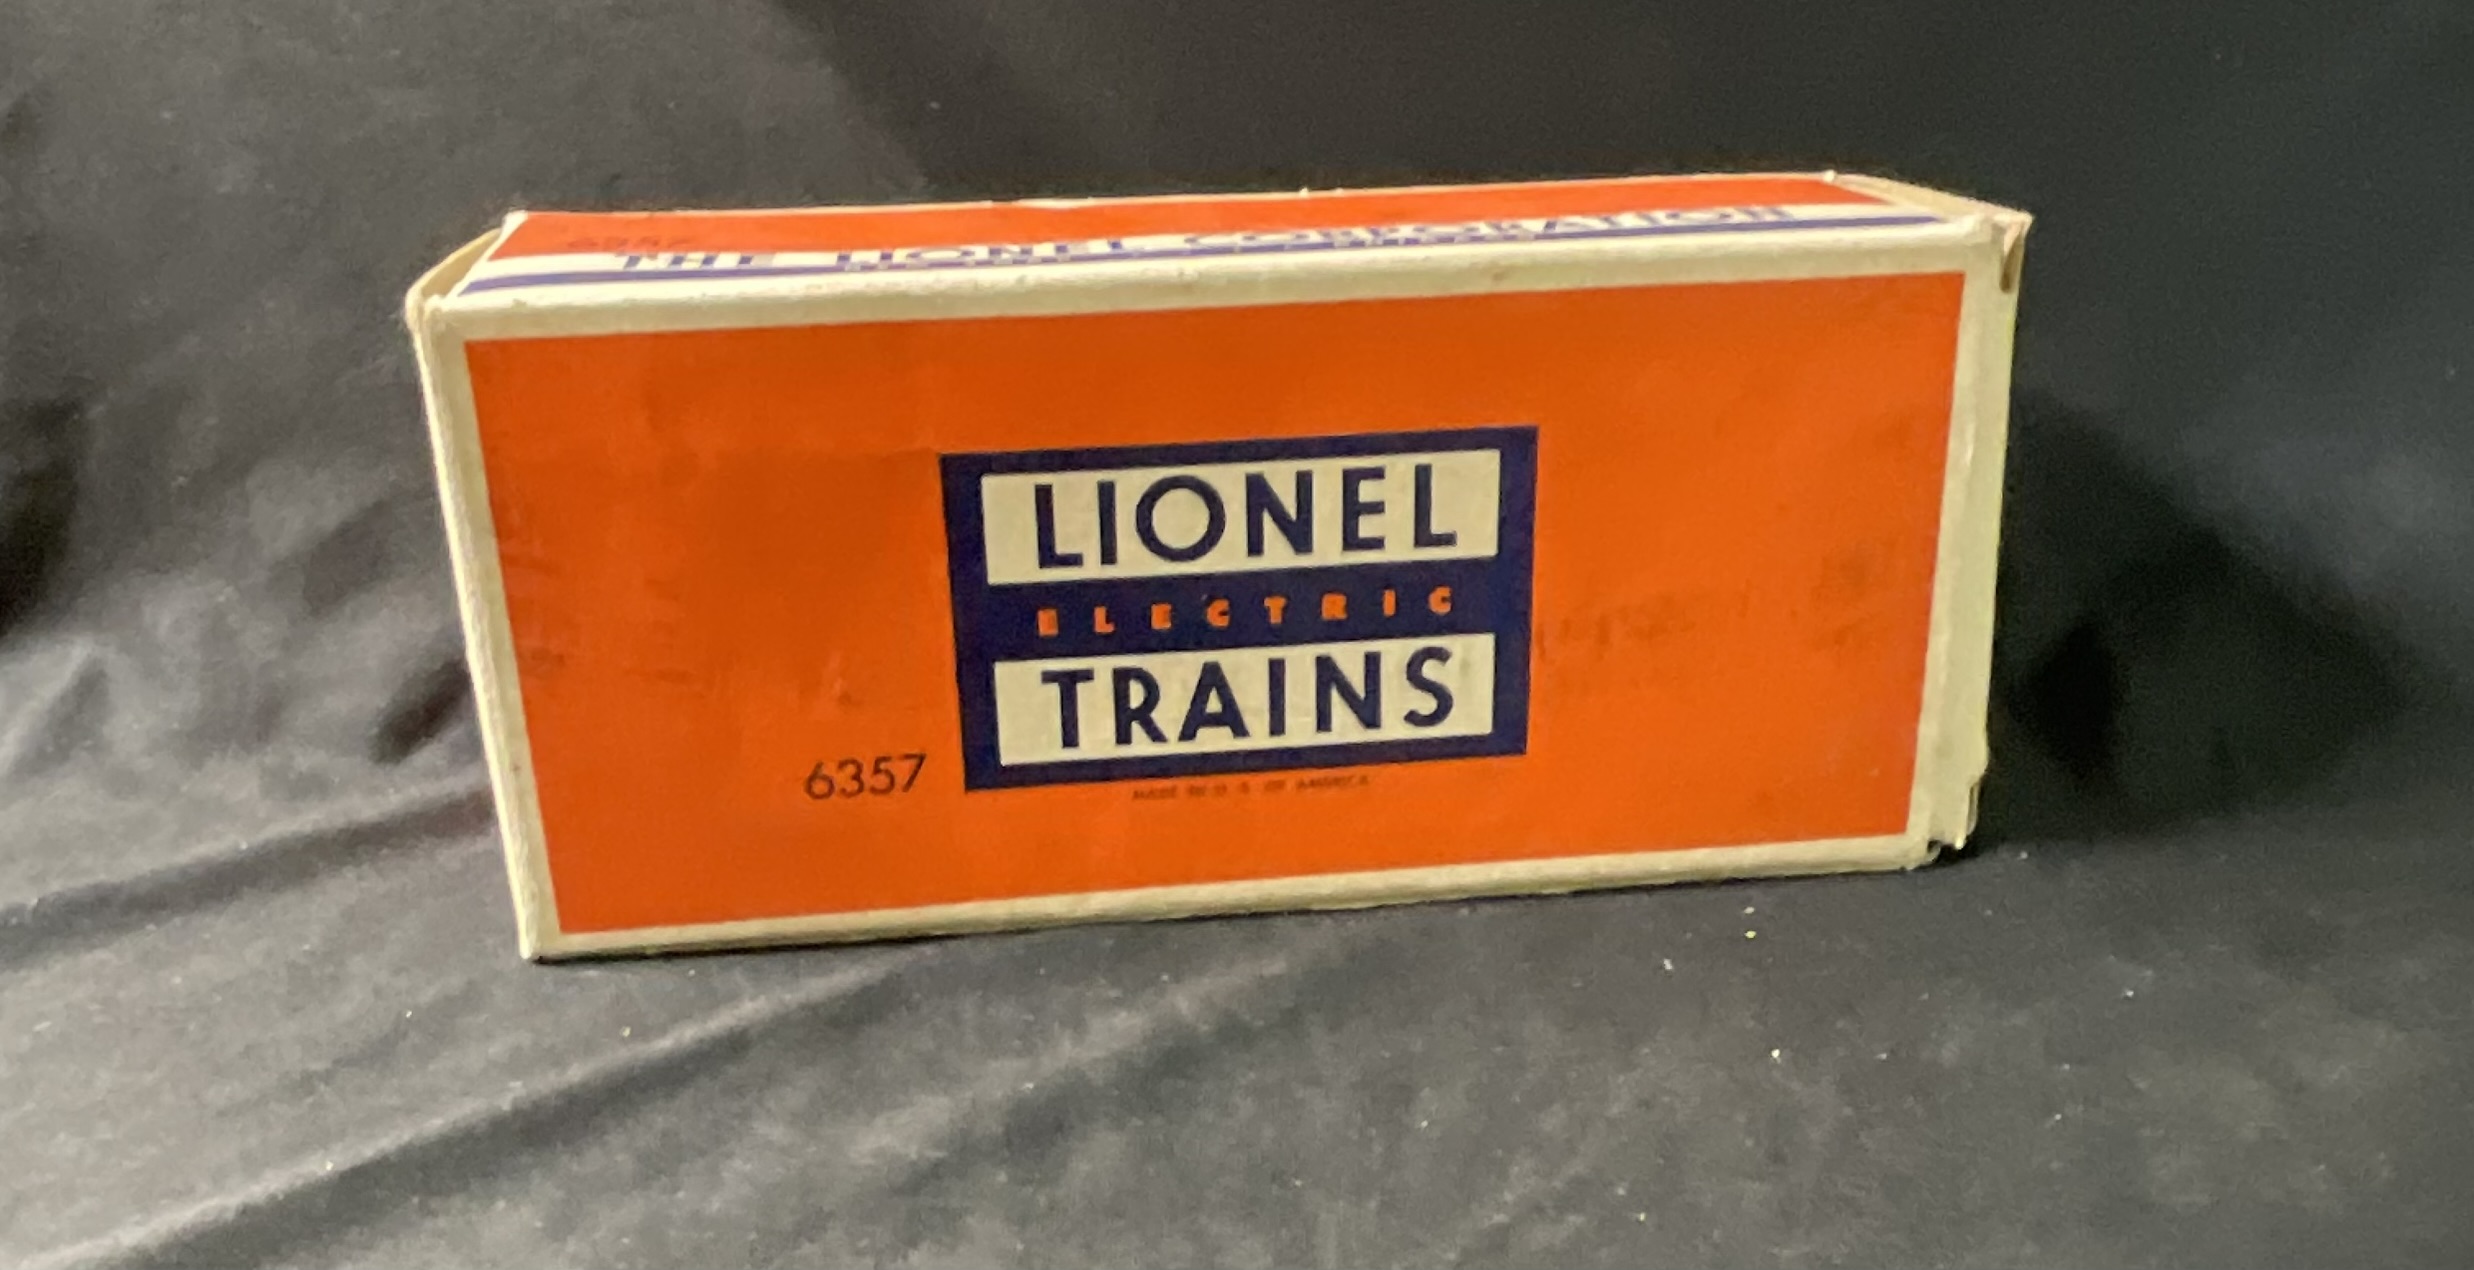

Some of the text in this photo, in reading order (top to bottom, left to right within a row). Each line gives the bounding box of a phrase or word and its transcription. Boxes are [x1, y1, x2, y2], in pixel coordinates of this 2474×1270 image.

[1034, 462, 1458, 570] LIONEL
[1036, 585, 1454, 638] ELECTRIC
[1040, 645, 1456, 750] TRAINS
[805, 752, 927, 800] 6357
